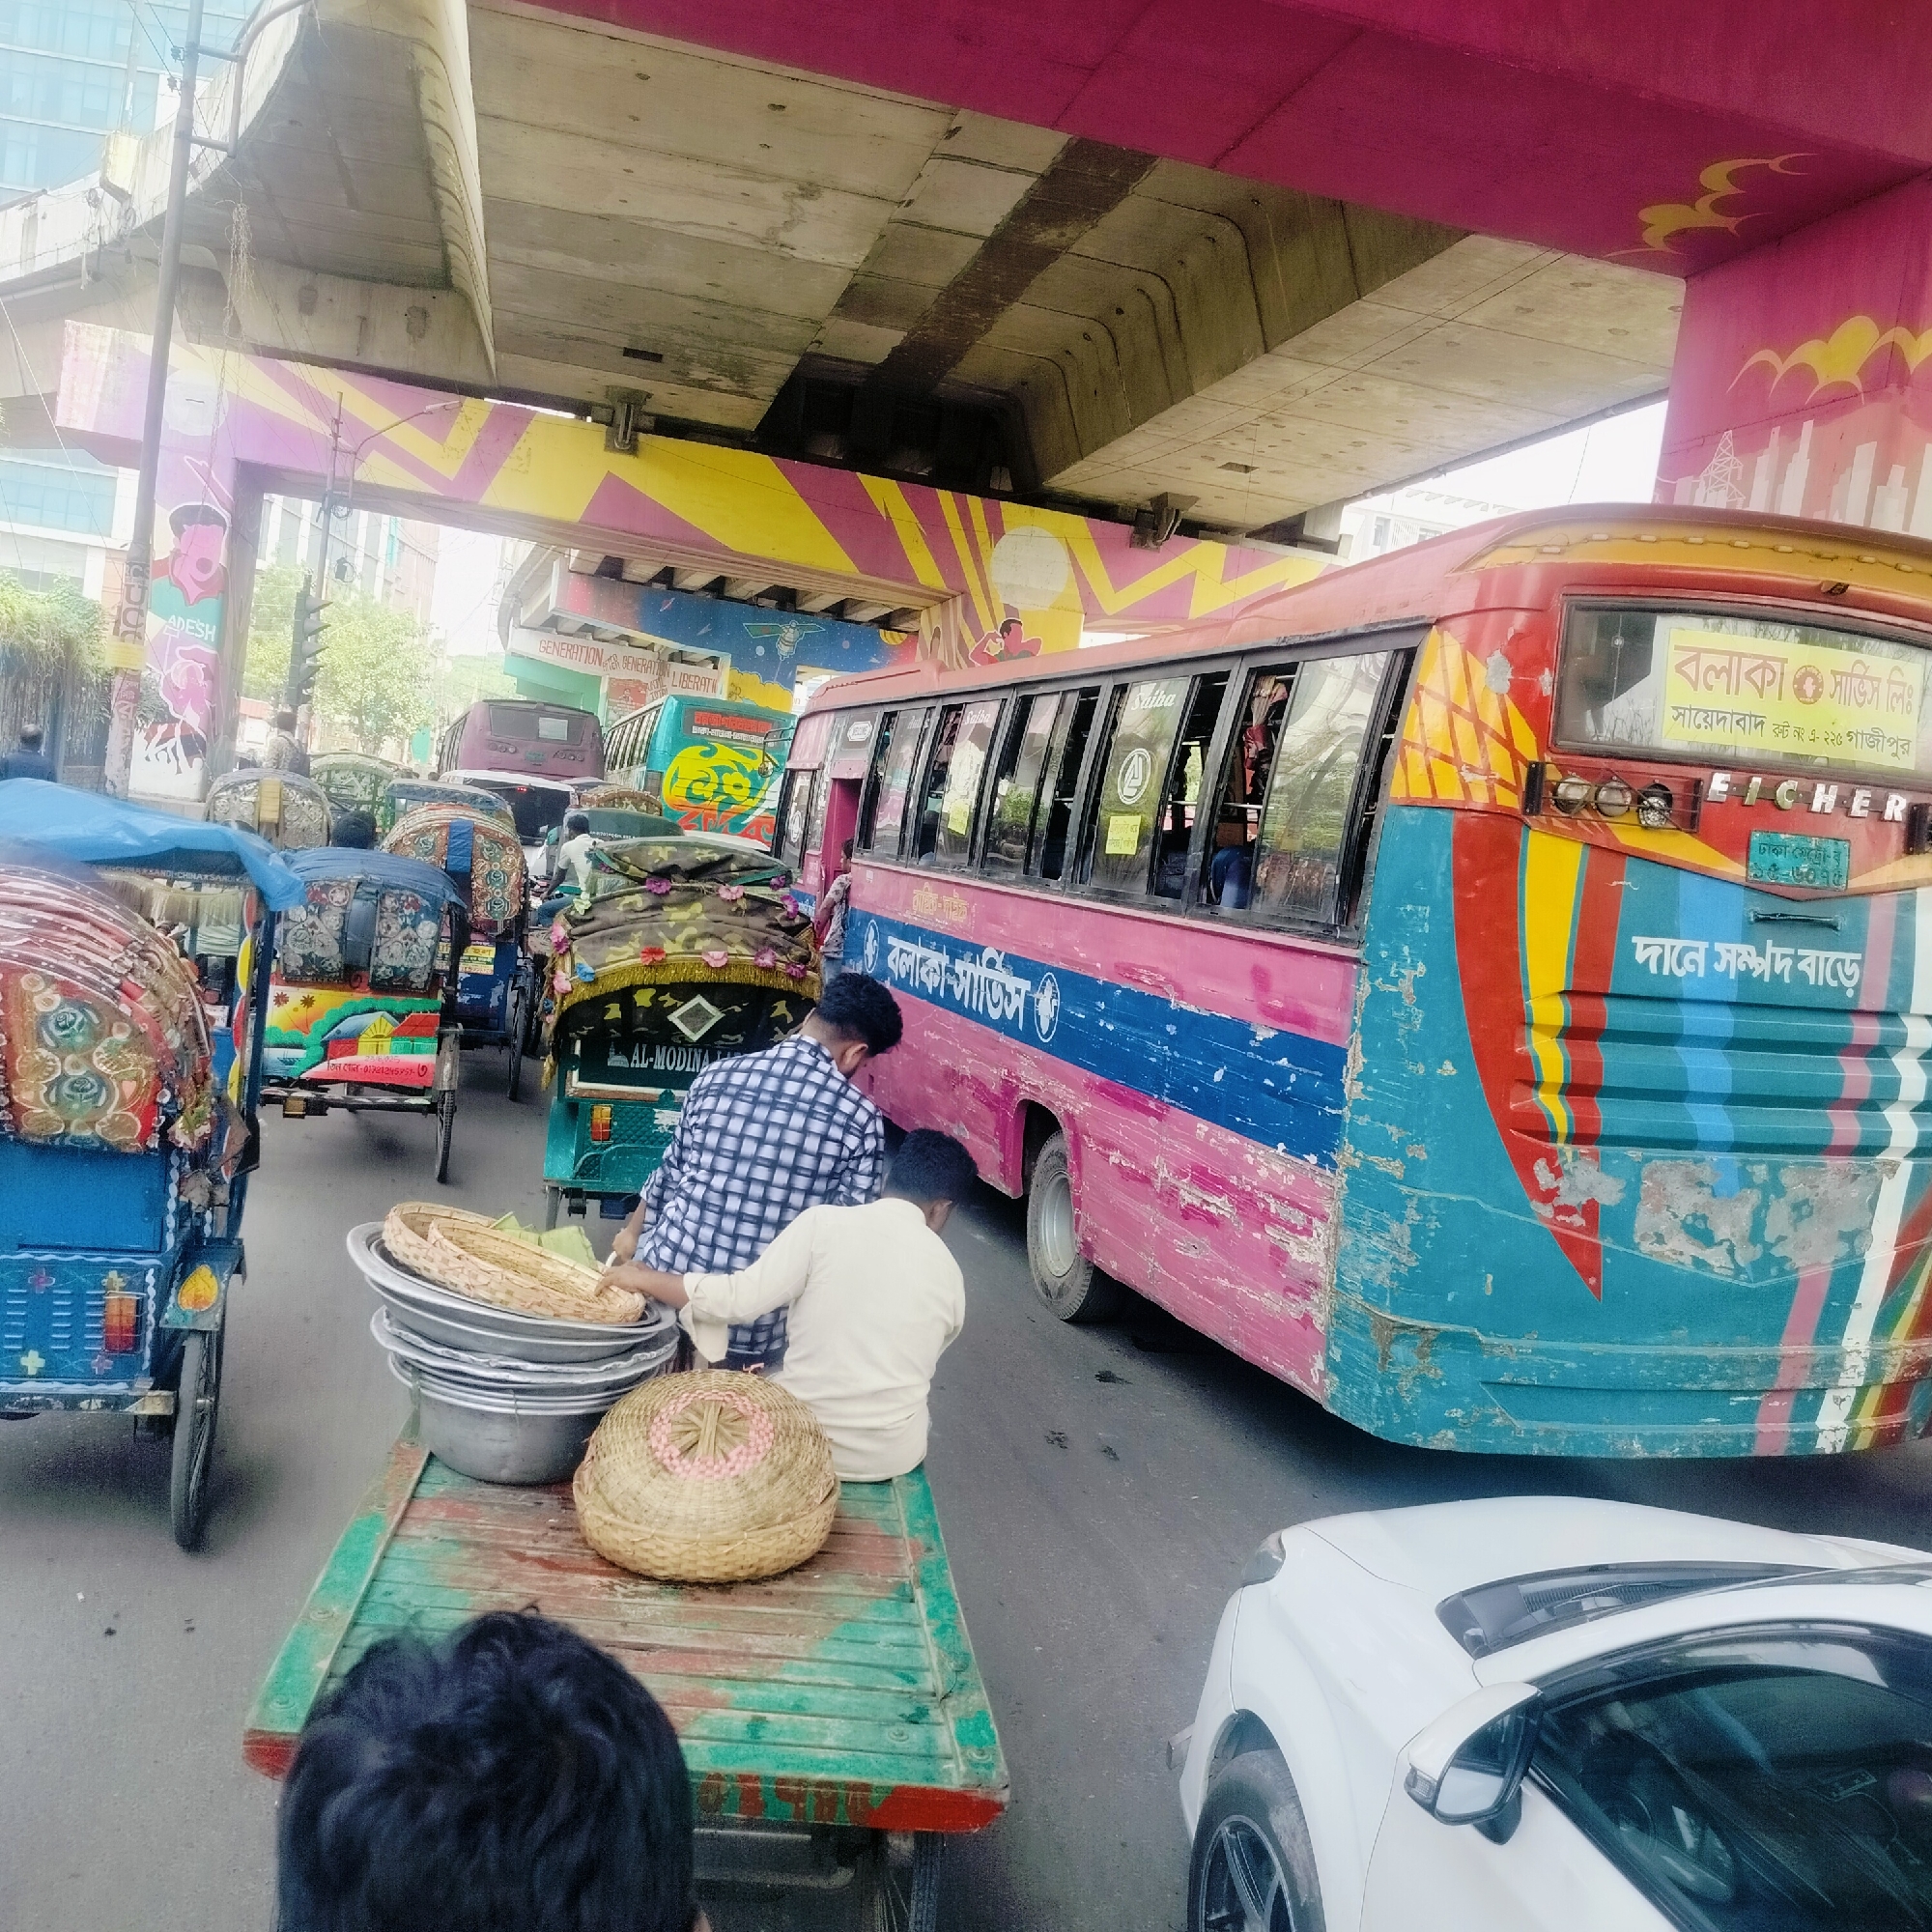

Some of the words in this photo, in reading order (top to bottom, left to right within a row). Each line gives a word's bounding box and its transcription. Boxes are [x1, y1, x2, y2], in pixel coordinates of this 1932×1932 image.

[167, 614, 217, 642] ADESH
[539, 639, 604, 668] GENERATION
[622, 655, 671, 679] GENERATION
[1674, 645, 1788, 701] বলাকা
[1830, 659, 1882, 711] সার্ভিস
[1131, 690, 1177, 711] Saiba
[1670, 704, 1767, 738] সায়েদাবাদ
[1846, 727, 1912, 760] গাজীপুর
[1707, 772, 1907, 822] EICHER
[887, 935, 950, 999] বলাকা
[954, 947, 1032, 1032] সার্ভিস
[1632, 936, 1709, 978] দানে
[1714, 939, 1795, 983] সম্পদ
[1798, 949, 1861, 998] বাড়ে
[630, 1043, 710, 1072] AL-MODINA
